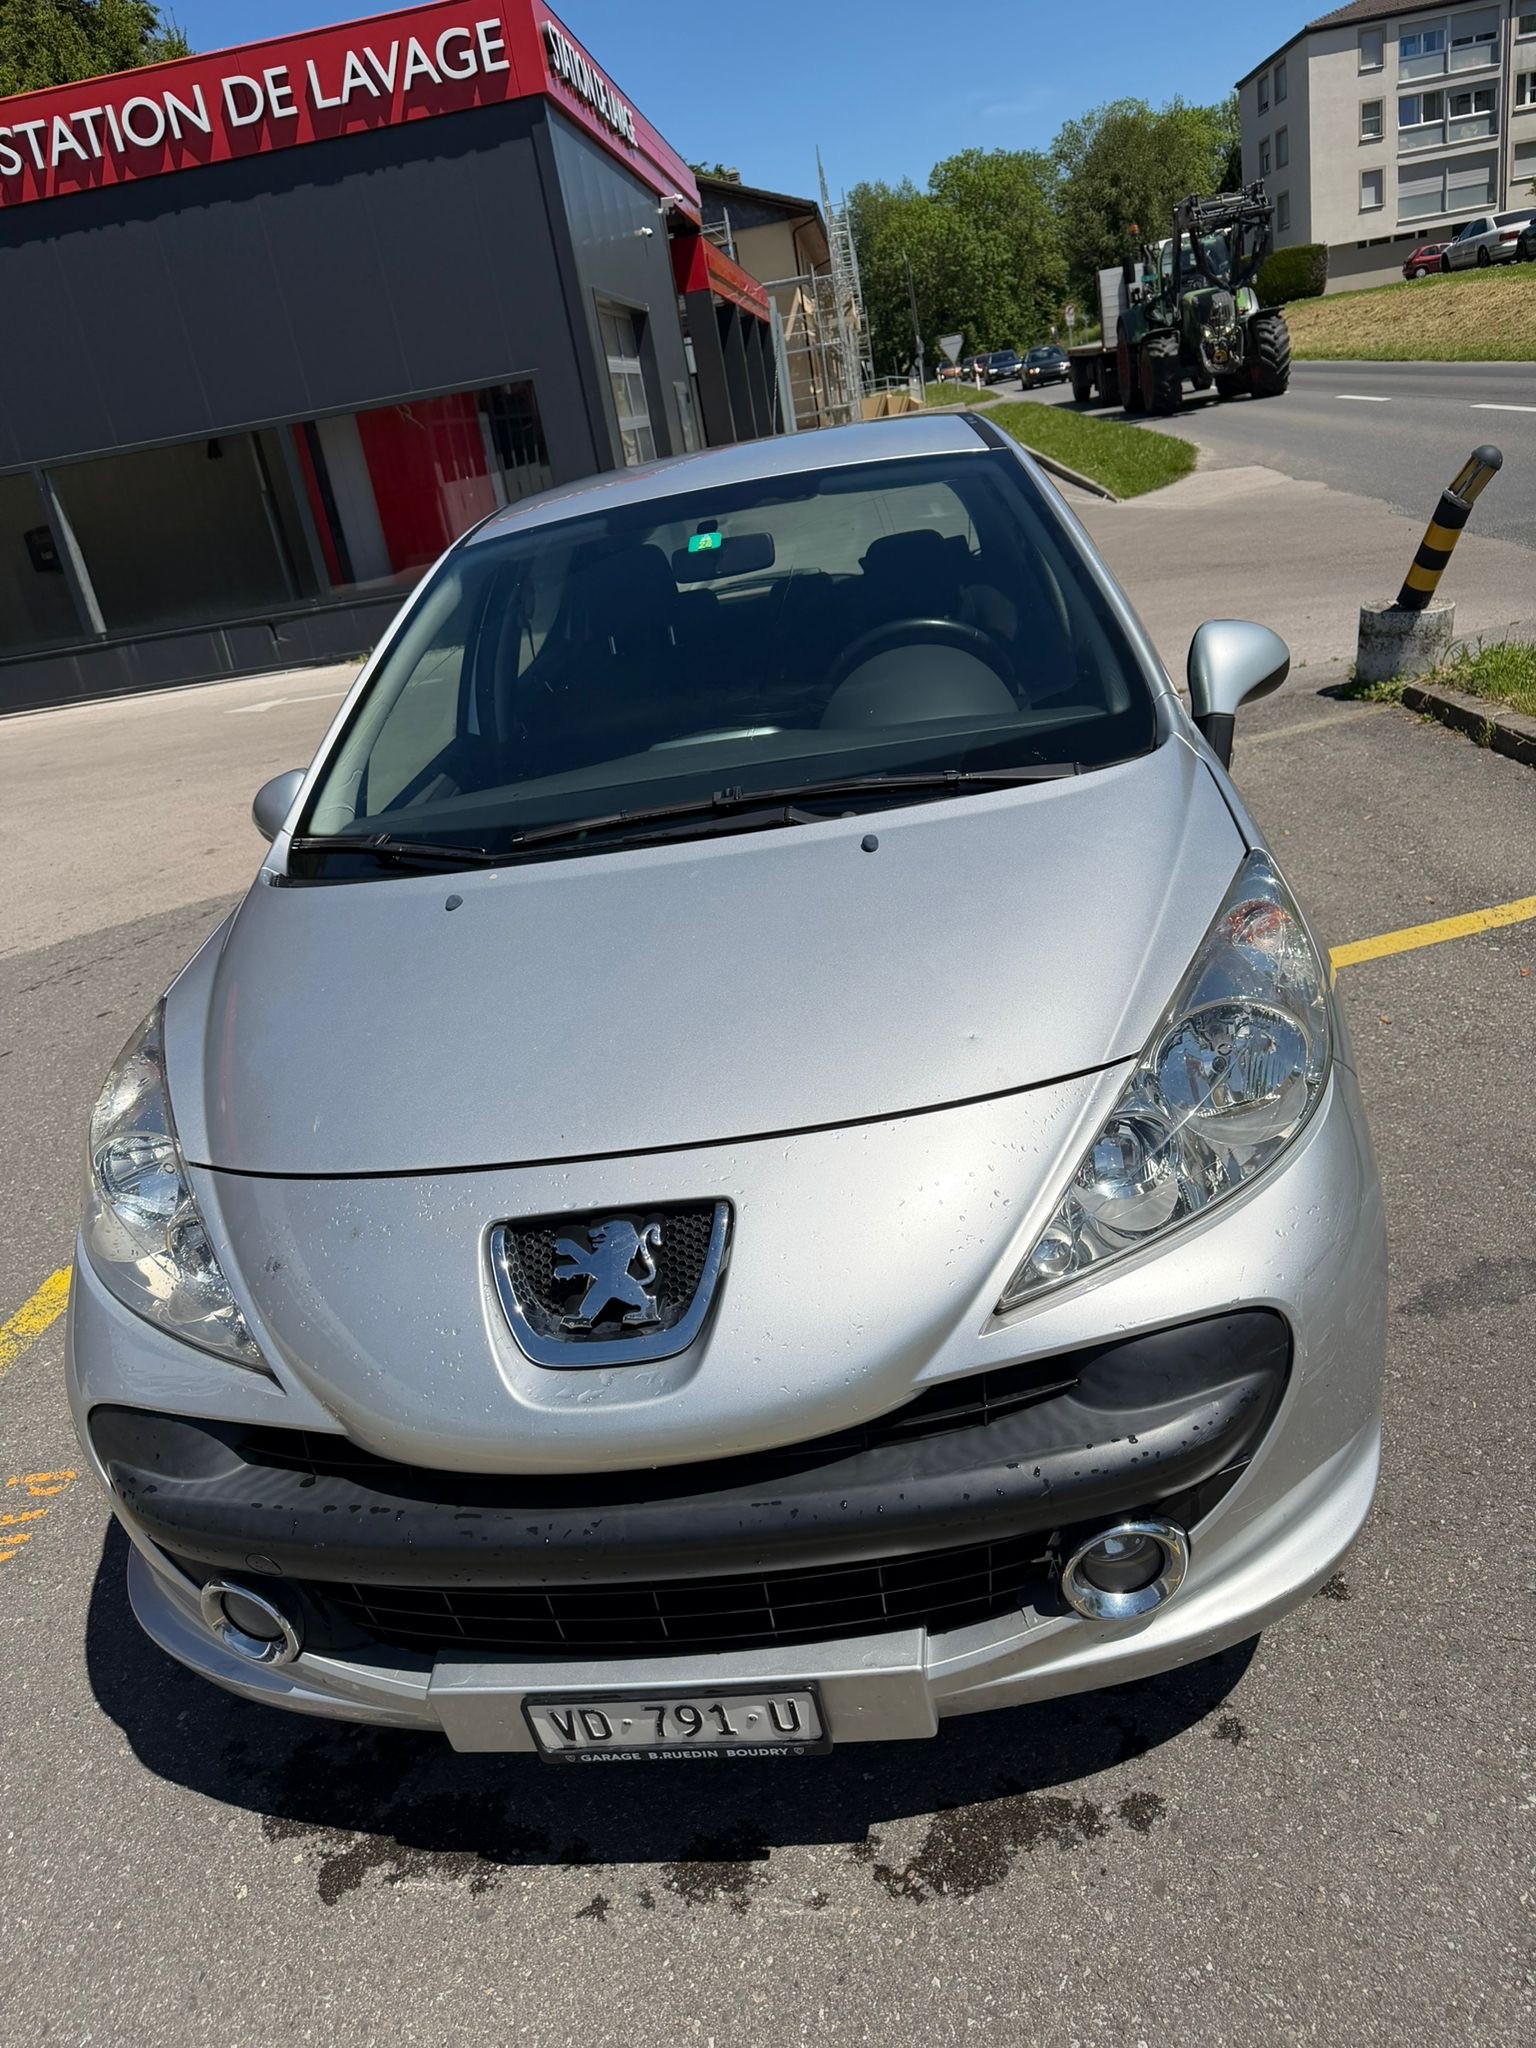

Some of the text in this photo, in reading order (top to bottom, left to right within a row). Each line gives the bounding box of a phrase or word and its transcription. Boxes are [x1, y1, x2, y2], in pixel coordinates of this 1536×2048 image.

[0, 18, 510, 175] STATION DE LAVAGE
[546, 19, 598, 106] STATION
[592, 69, 611, 121] DE
[548, 1697, 802, 1742] VD 791 U
[580, 1747, 789, 1762] GARAGE B.RUEDIN BOUDRY
